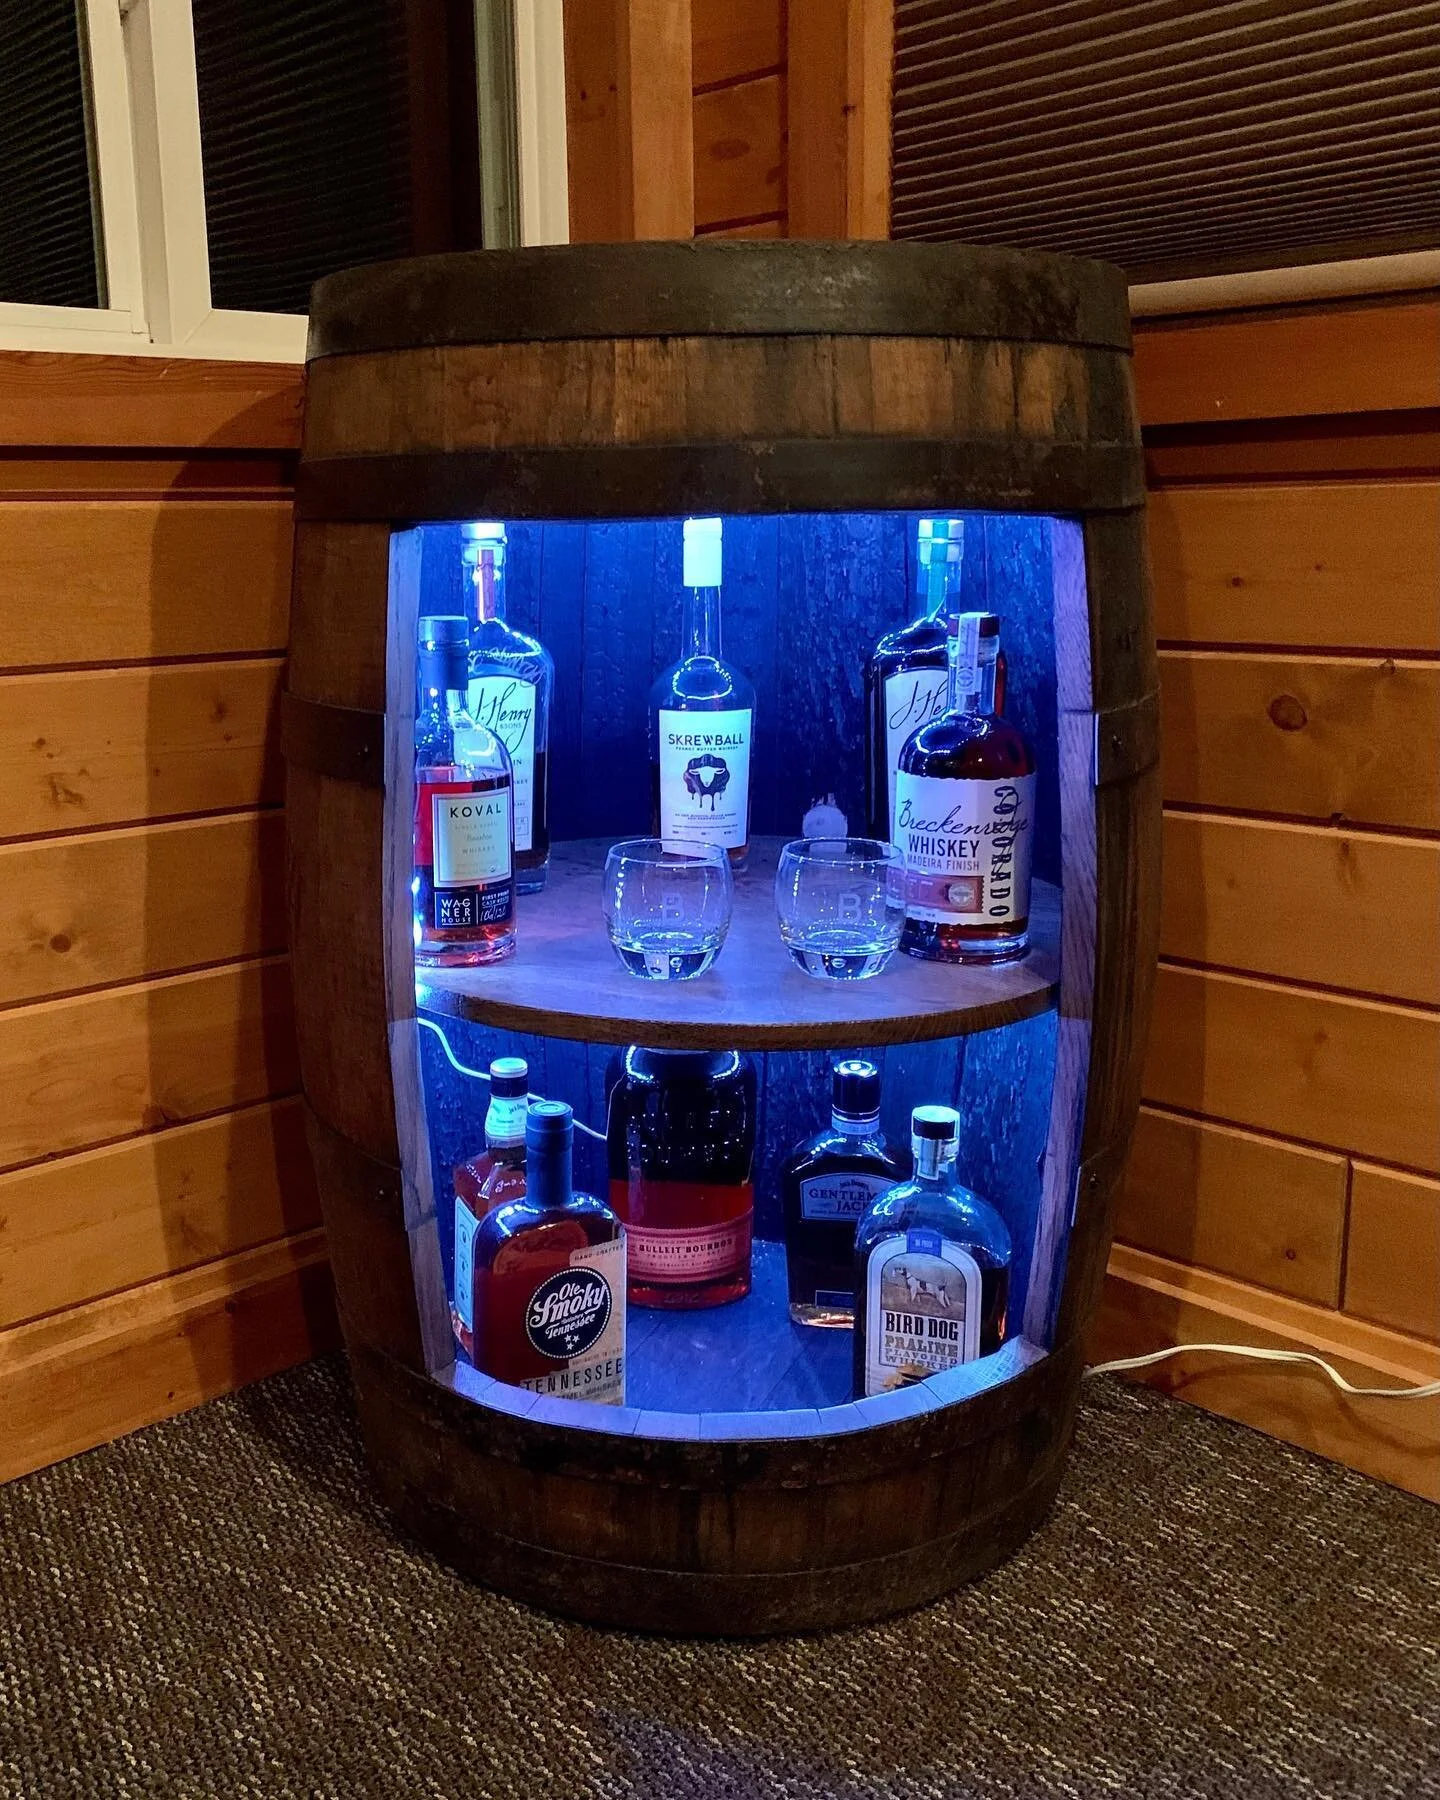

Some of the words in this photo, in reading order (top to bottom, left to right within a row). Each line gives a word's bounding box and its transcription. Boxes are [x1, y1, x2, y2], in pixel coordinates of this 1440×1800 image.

[483, 682, 532, 754] Henry
[668, 732, 745, 747] SKREWBALL
[450, 803, 502, 818] KOVAL
[898, 791, 1028, 874] Breckenridge
[908, 833, 980, 858] WHISKEY
[989, 785, 1017, 917] COLORADO
[907, 854, 942, 870] MADEIRA
[946, 859, 980, 872] FINISH
[441, 898, 471, 909] WAG
[441, 908, 471, 918] NER
[838, 892, 863, 922] B
[808, 1187, 877, 1202] GENTLEM
[639, 1244, 681, 1254] BULLEIT
[685, 1238, 733, 1254] BOURBON
[559, 1282, 585, 1300] Ole
[529, 1282, 607, 1328] Smoky
[545, 1313, 596, 1340] Tennessee
[885, 1312, 924, 1336] BIRD
[928, 1318, 959, 1341] DOG
[884, 1334, 958, 1358] PRALINE
[885, 1347, 958, 1364] FLAVORED
[525, 1357, 622, 1394] TENNESSEE
